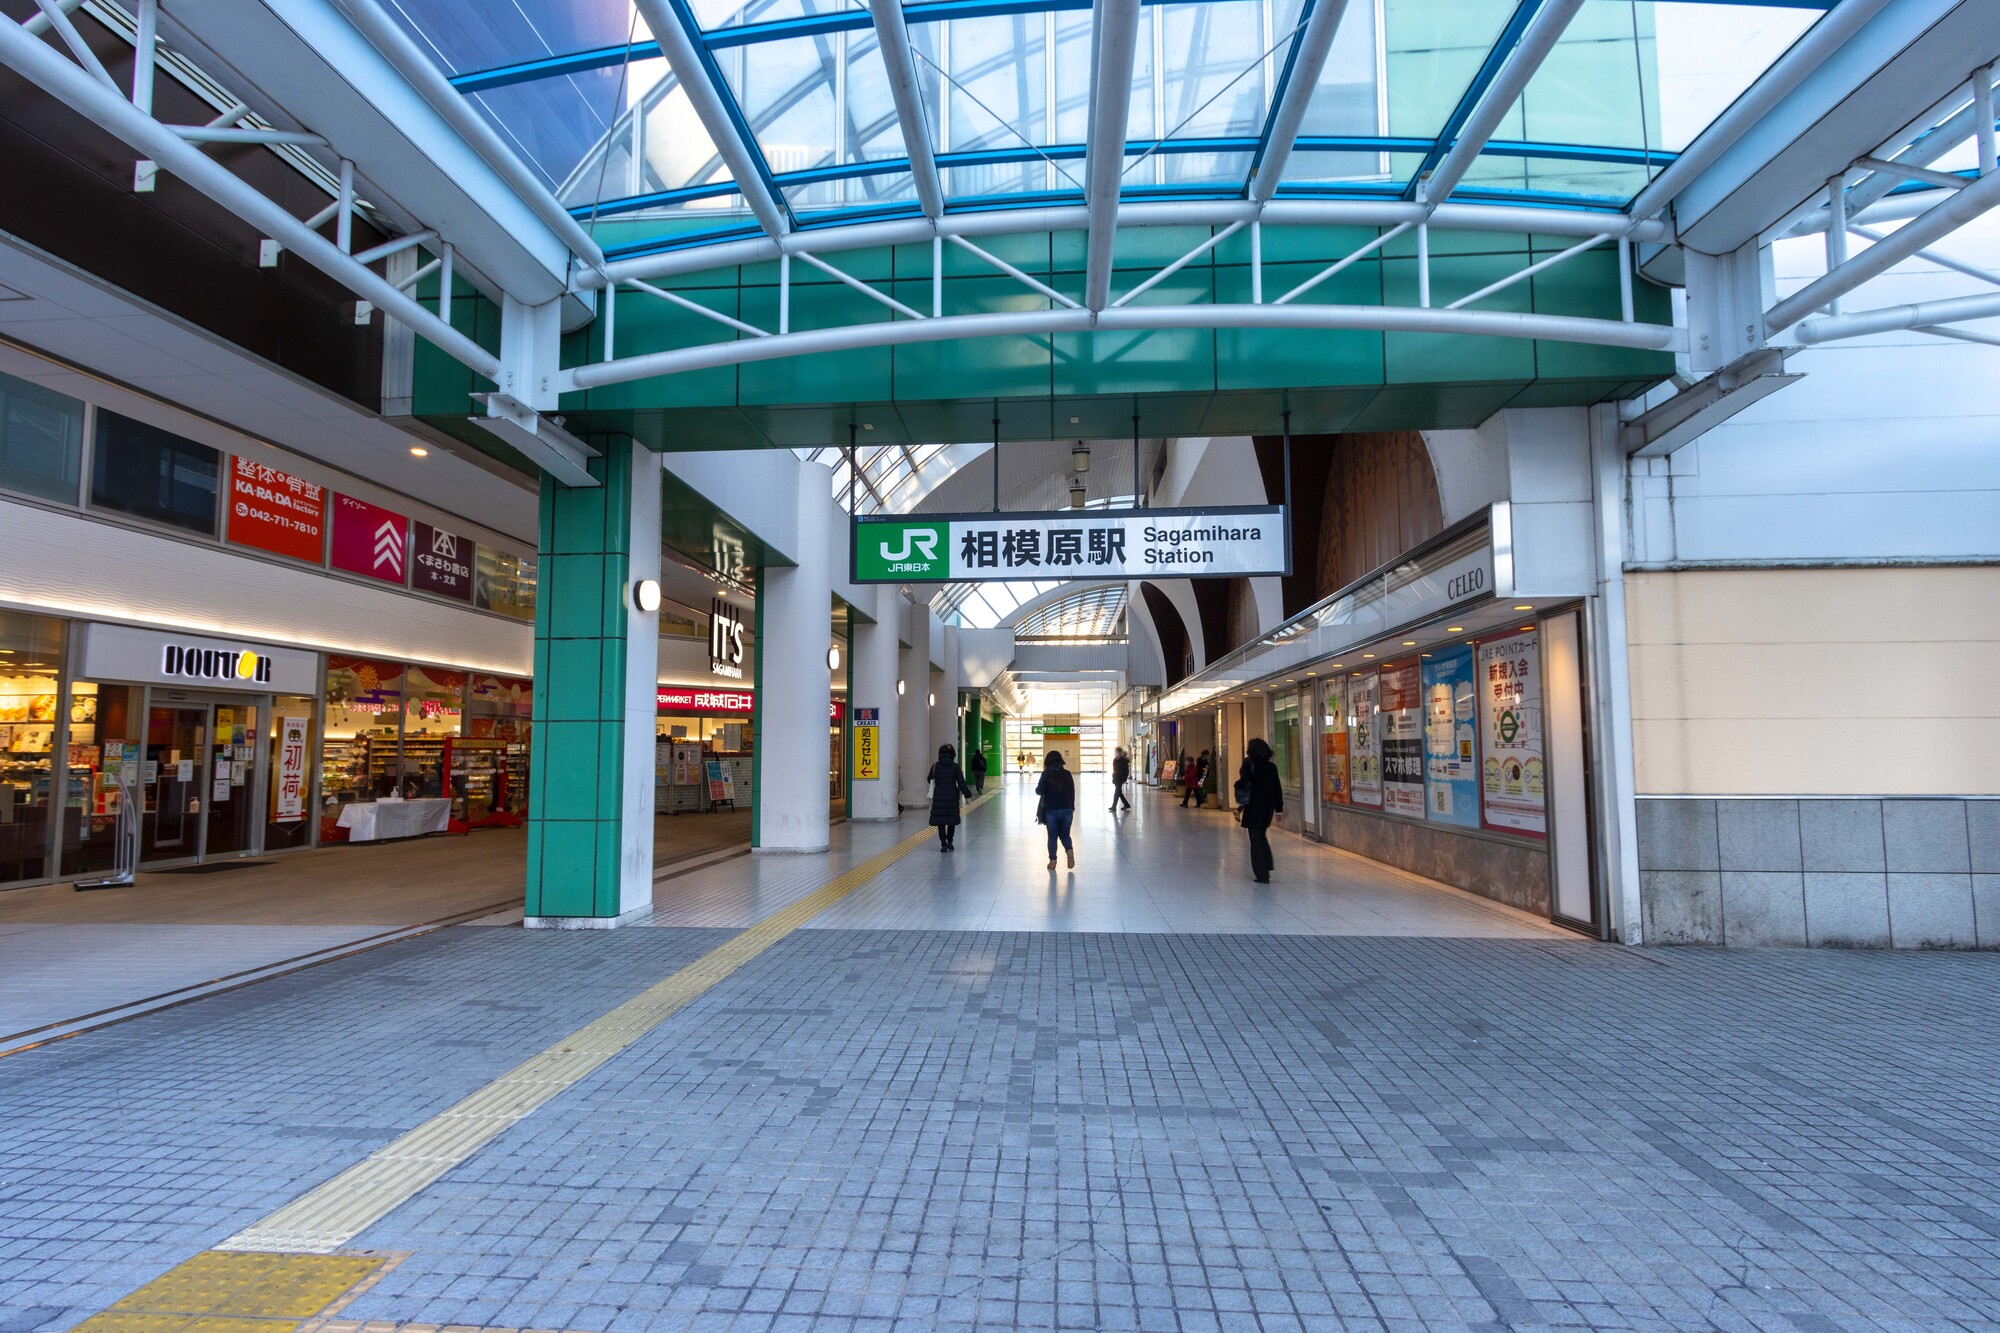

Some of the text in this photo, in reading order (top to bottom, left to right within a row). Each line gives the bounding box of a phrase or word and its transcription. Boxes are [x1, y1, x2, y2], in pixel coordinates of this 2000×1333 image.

[292, 501, 320, 518] factory
[342, 498, 367, 511] ダイソー
[250, 508, 318, 536] 042-711-7810
[880, 528, 938, 561] JR
[961, 527, 1127, 568] 相模原駅
[1143, 525, 1261, 546] Sagamihara
[887, 562, 931, 573] JR東日本
[1143, 547, 1214, 564] Station
[1448, 567, 1483, 600] CELEO
[713, 613, 744, 664] IT'S
[1481, 637, 1537, 661] JRE POINTカード
[164, 645, 272, 683] DOUTOR
[712, 662, 742, 680] SAGAMIHARA
[1489, 658, 1529, 682] 新規入会
[694, 693, 752, 709] 成城石井
[1494, 680, 1524, 699] 受付中
[861, 728, 871, 766] 処方せん
[282, 745, 303, 799] 初荷
[1385, 756, 1422, 776] スマホ修理
